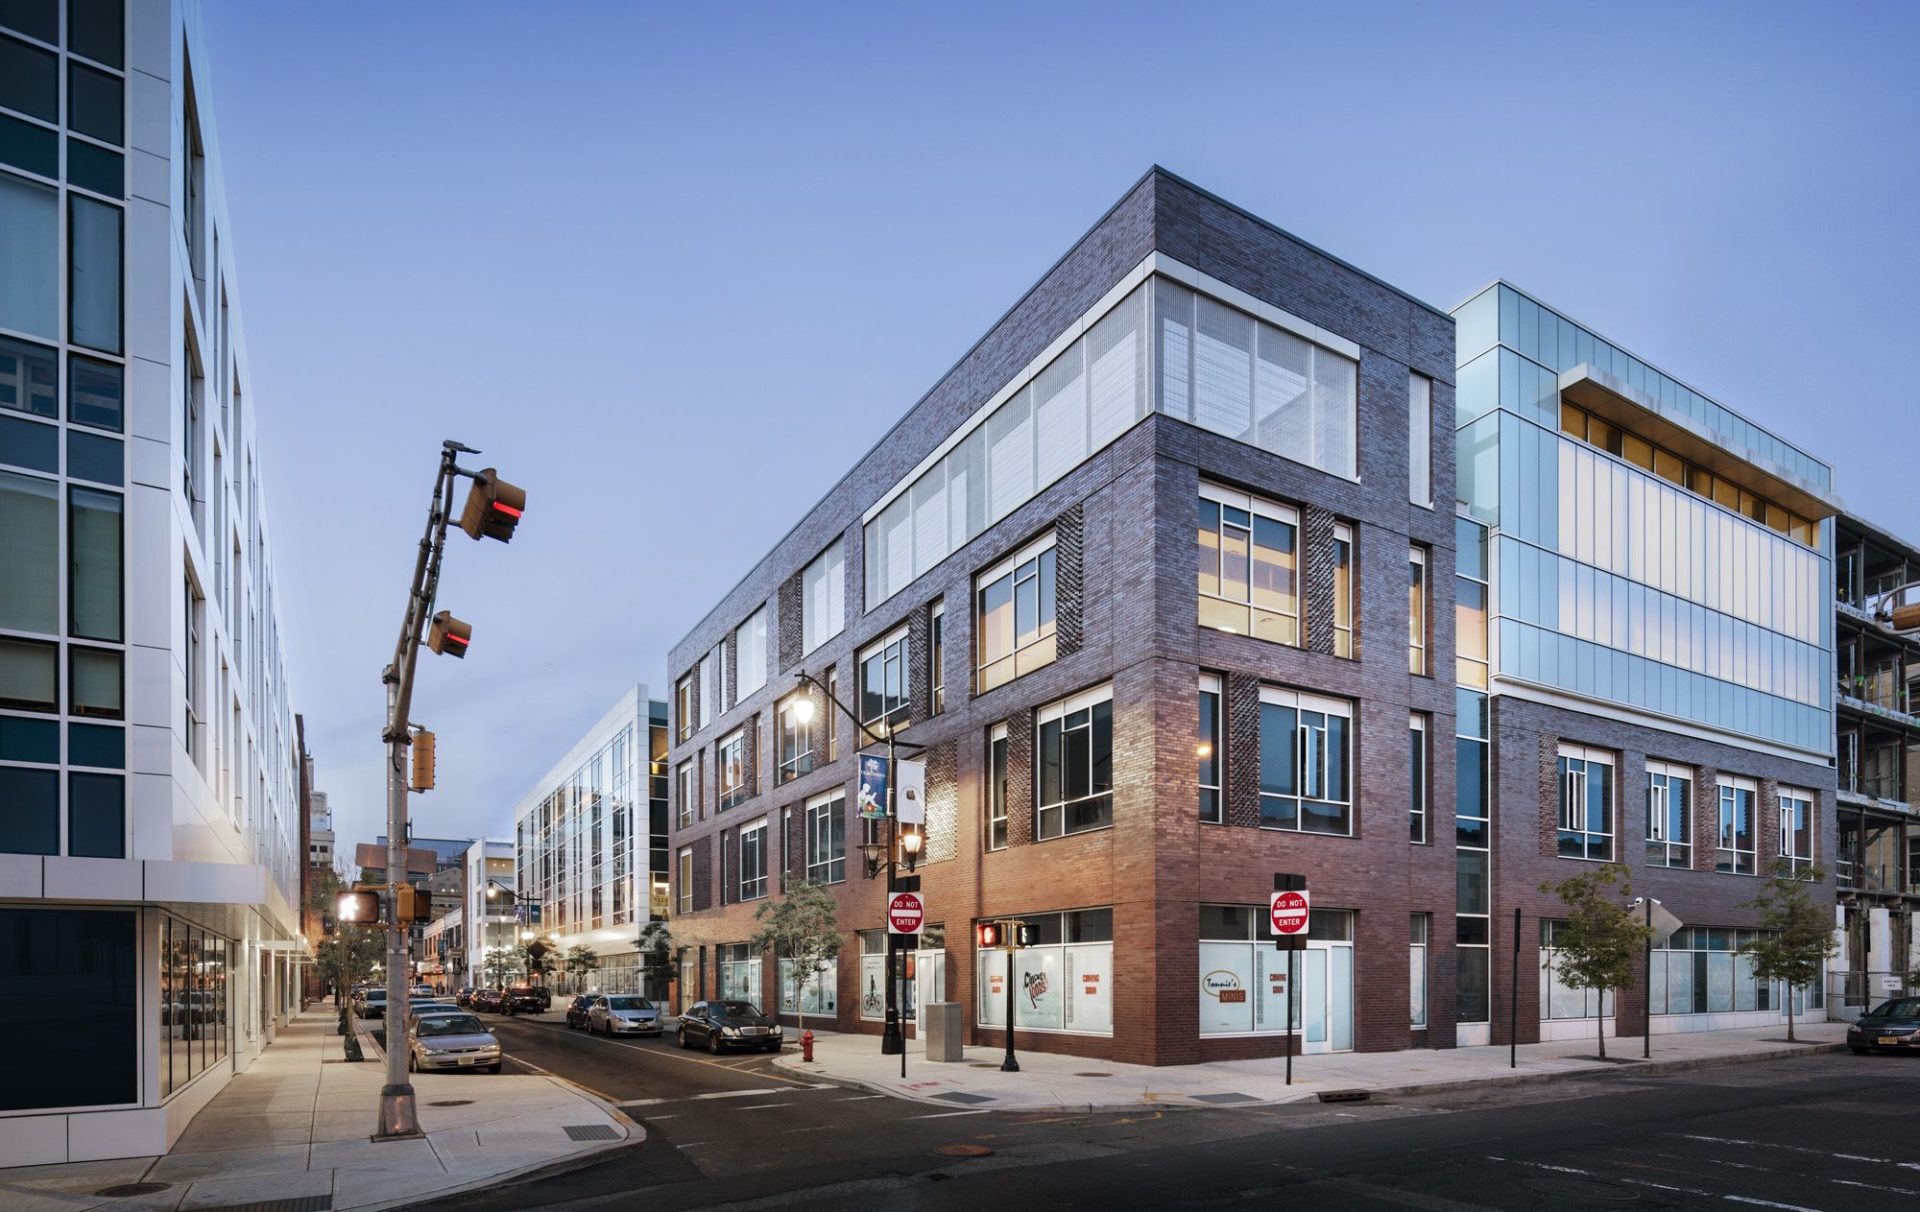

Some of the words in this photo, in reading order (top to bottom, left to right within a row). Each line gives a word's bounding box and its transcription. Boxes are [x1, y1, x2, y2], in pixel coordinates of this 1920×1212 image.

[1289, 899, 1303, 907] NOT
[896, 918, 916, 926] ENTER
[1279, 918, 1300, 926] ENTER
